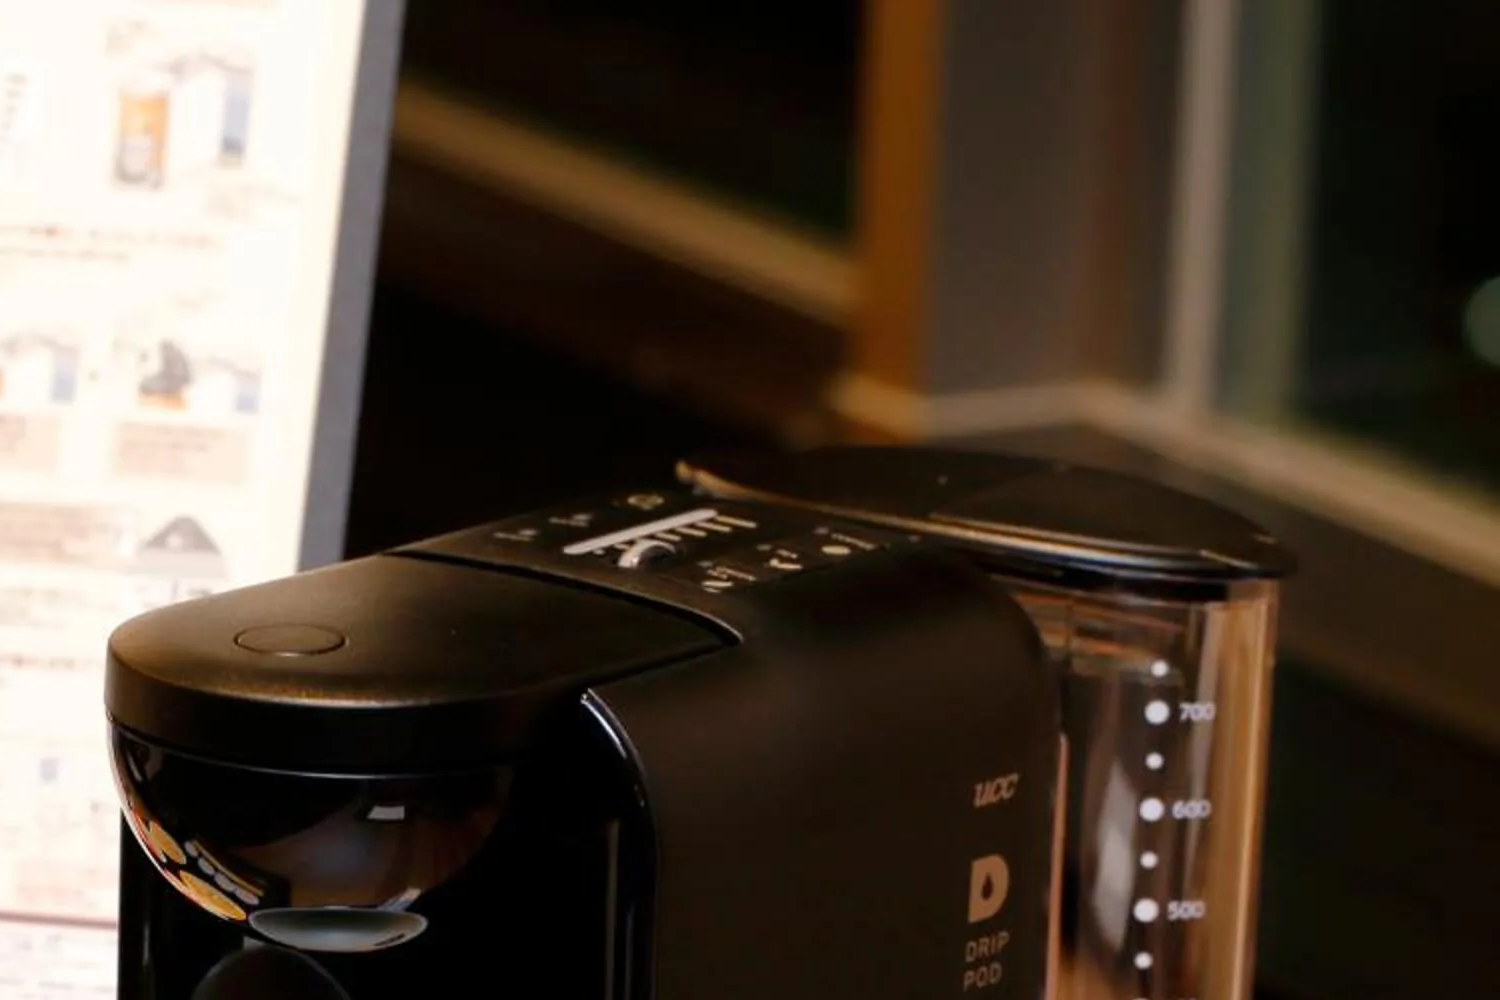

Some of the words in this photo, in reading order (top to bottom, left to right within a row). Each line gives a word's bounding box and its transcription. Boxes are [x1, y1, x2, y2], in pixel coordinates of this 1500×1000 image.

[1179, 703, 1216, 722] 700
[974, 772, 1019, 809] UCC
[1172, 800, 1212, 820] 600
[1167, 901, 1206, 921] 500
[965, 931, 1010, 963] DRIP
[963, 963, 1002, 992] POD
